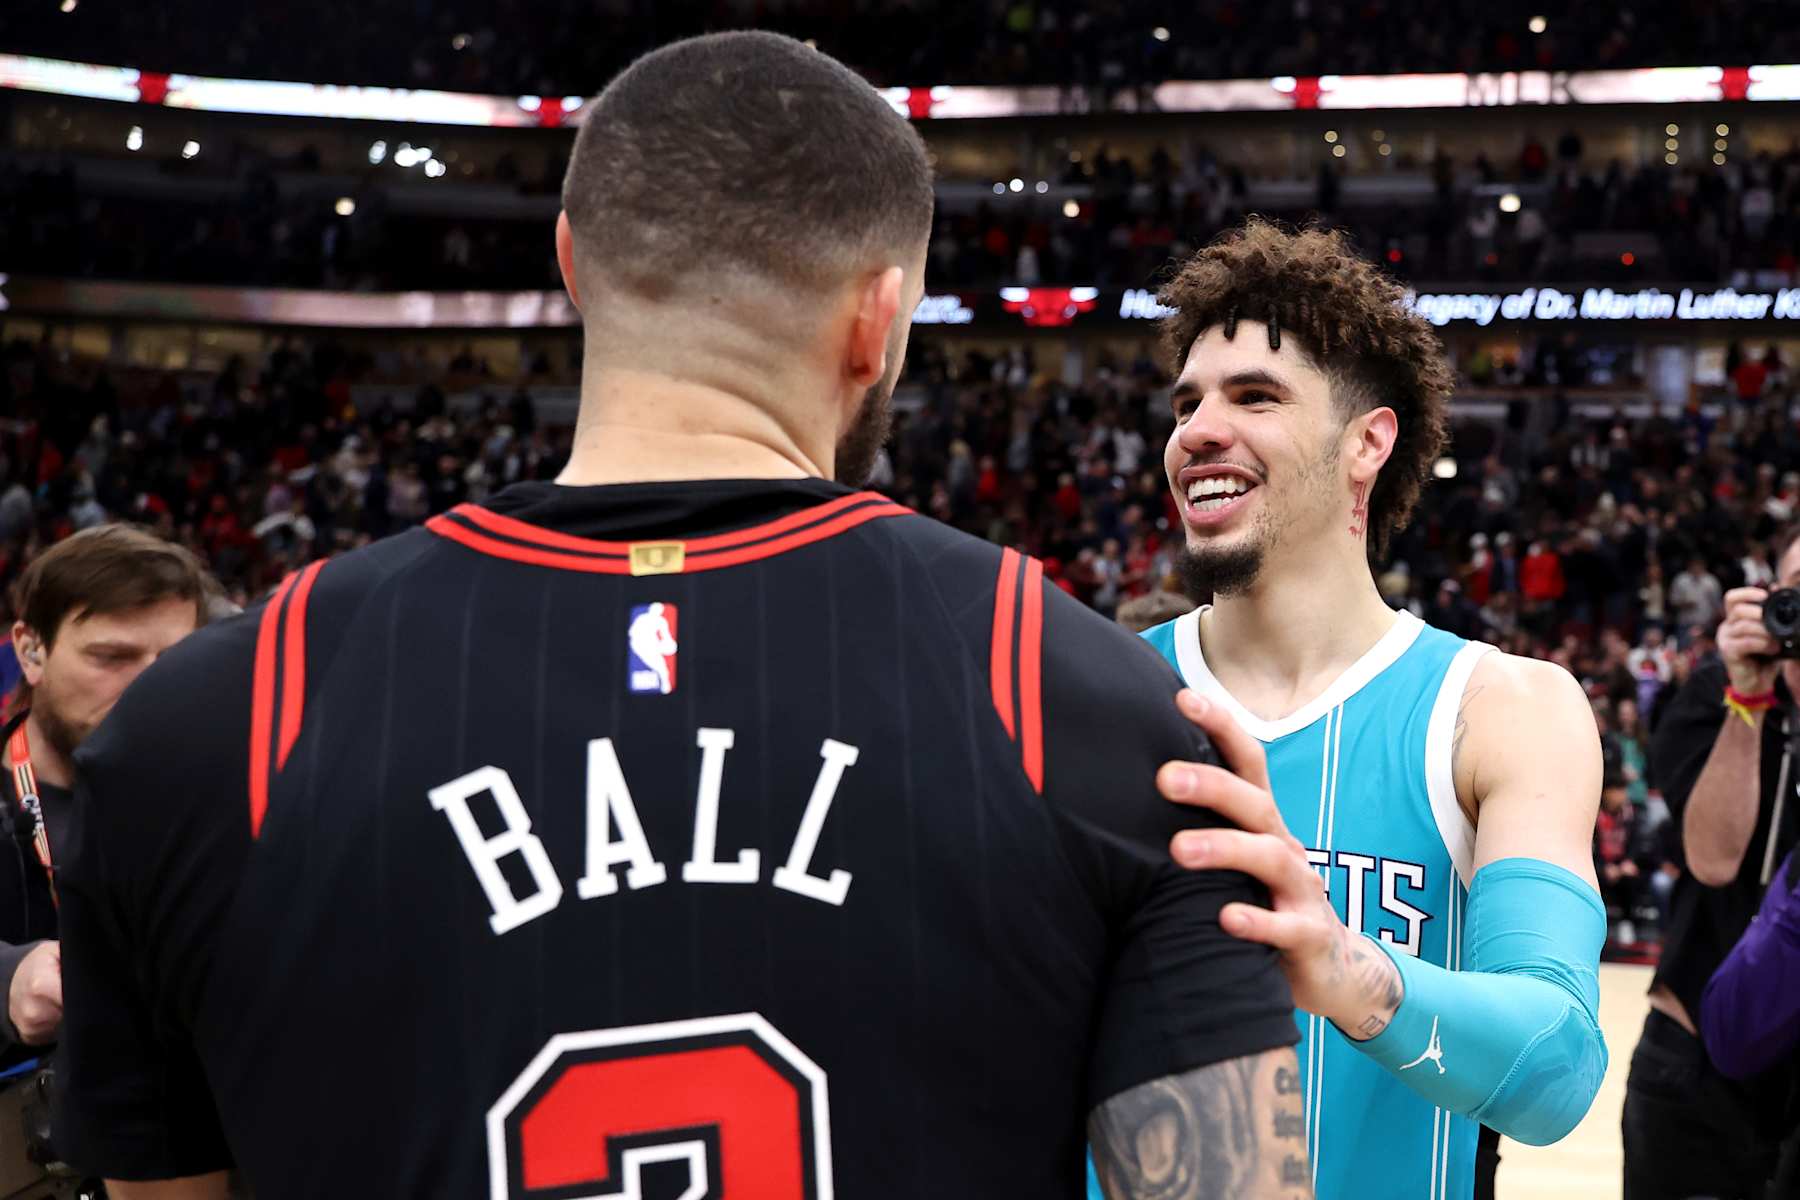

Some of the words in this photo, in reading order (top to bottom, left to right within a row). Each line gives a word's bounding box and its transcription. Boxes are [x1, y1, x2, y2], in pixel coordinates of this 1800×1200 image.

[1501, 287, 1537, 319] of
[1535, 287, 1577, 319] Dr.
[1579, 287, 1676, 319] Martin
[1676, 287, 1774, 319] Luther
[428, 727, 860, 935] BALL
[1305, 848, 1434, 959] TS
